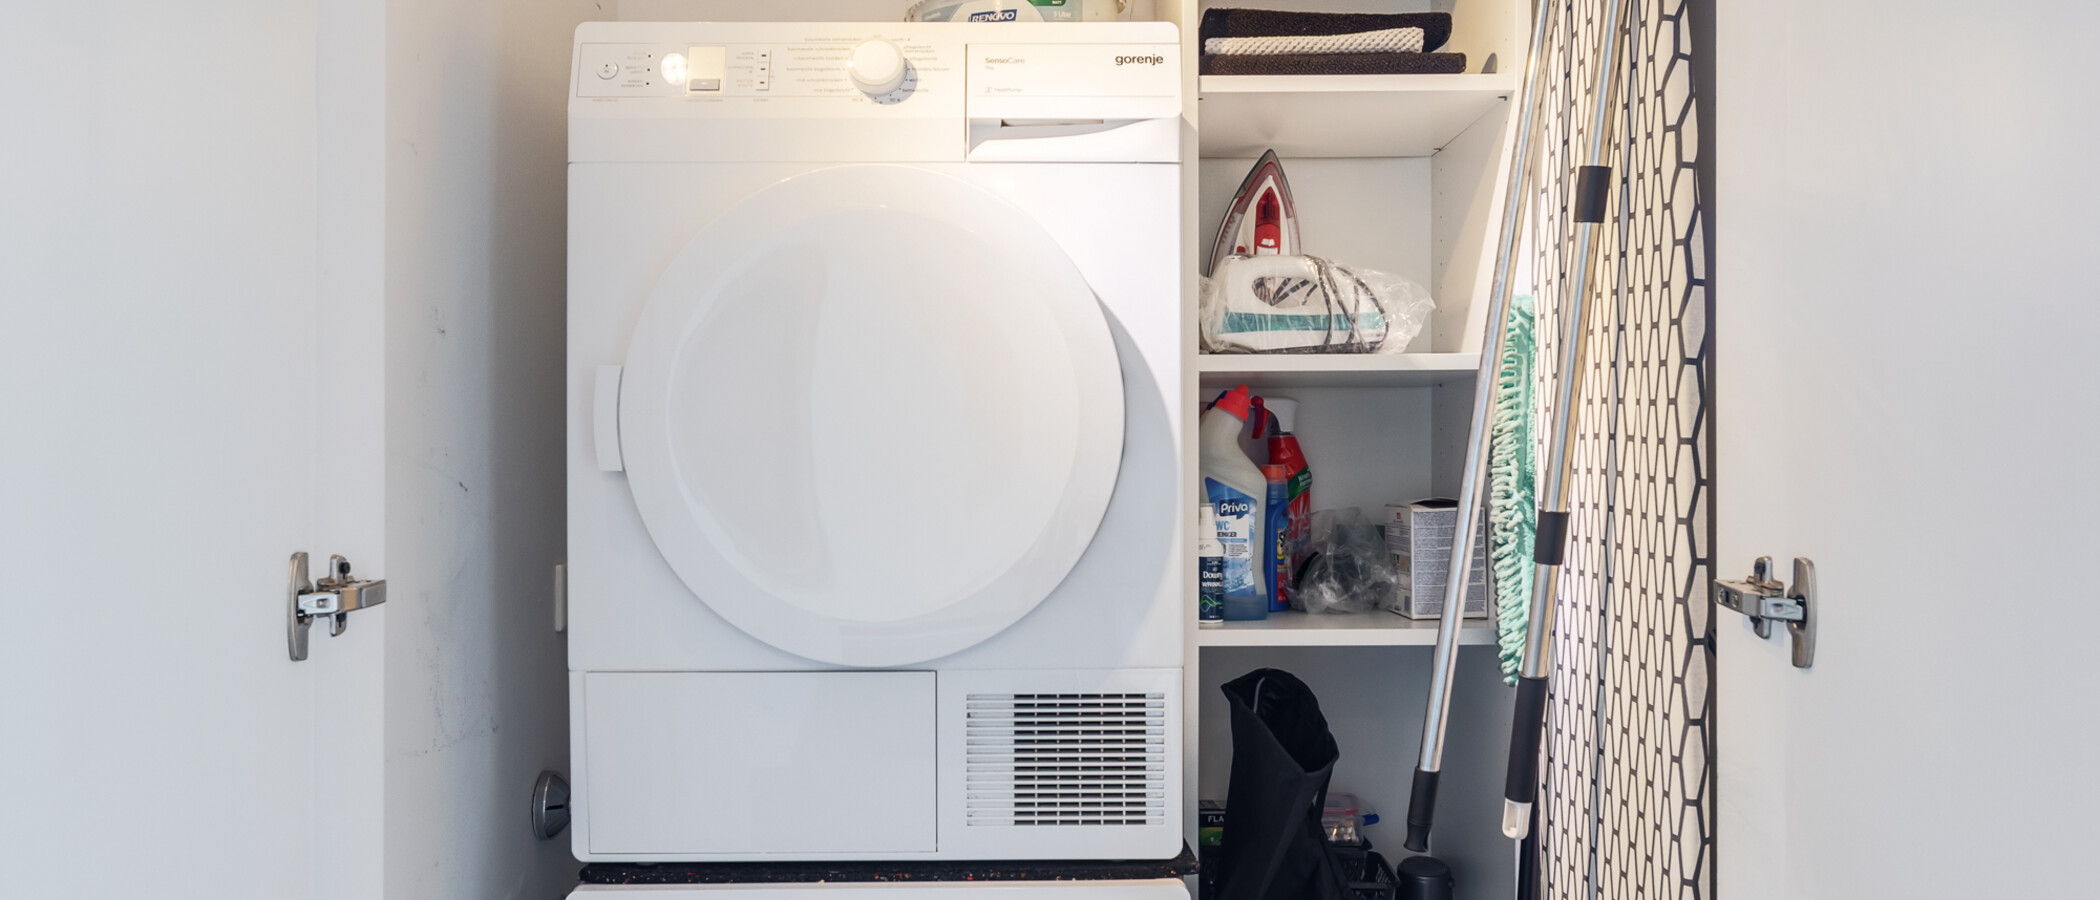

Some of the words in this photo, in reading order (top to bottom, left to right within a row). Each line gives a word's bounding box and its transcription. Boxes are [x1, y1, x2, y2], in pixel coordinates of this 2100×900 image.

[972, 10, 1016, 22] RENOVO
[984, 56, 1025, 64] SensoCare
[1115, 54, 1163, 65] gorenje
[1220, 502, 1248, 514] Priva
[1216, 520, 1230, 531] WC
